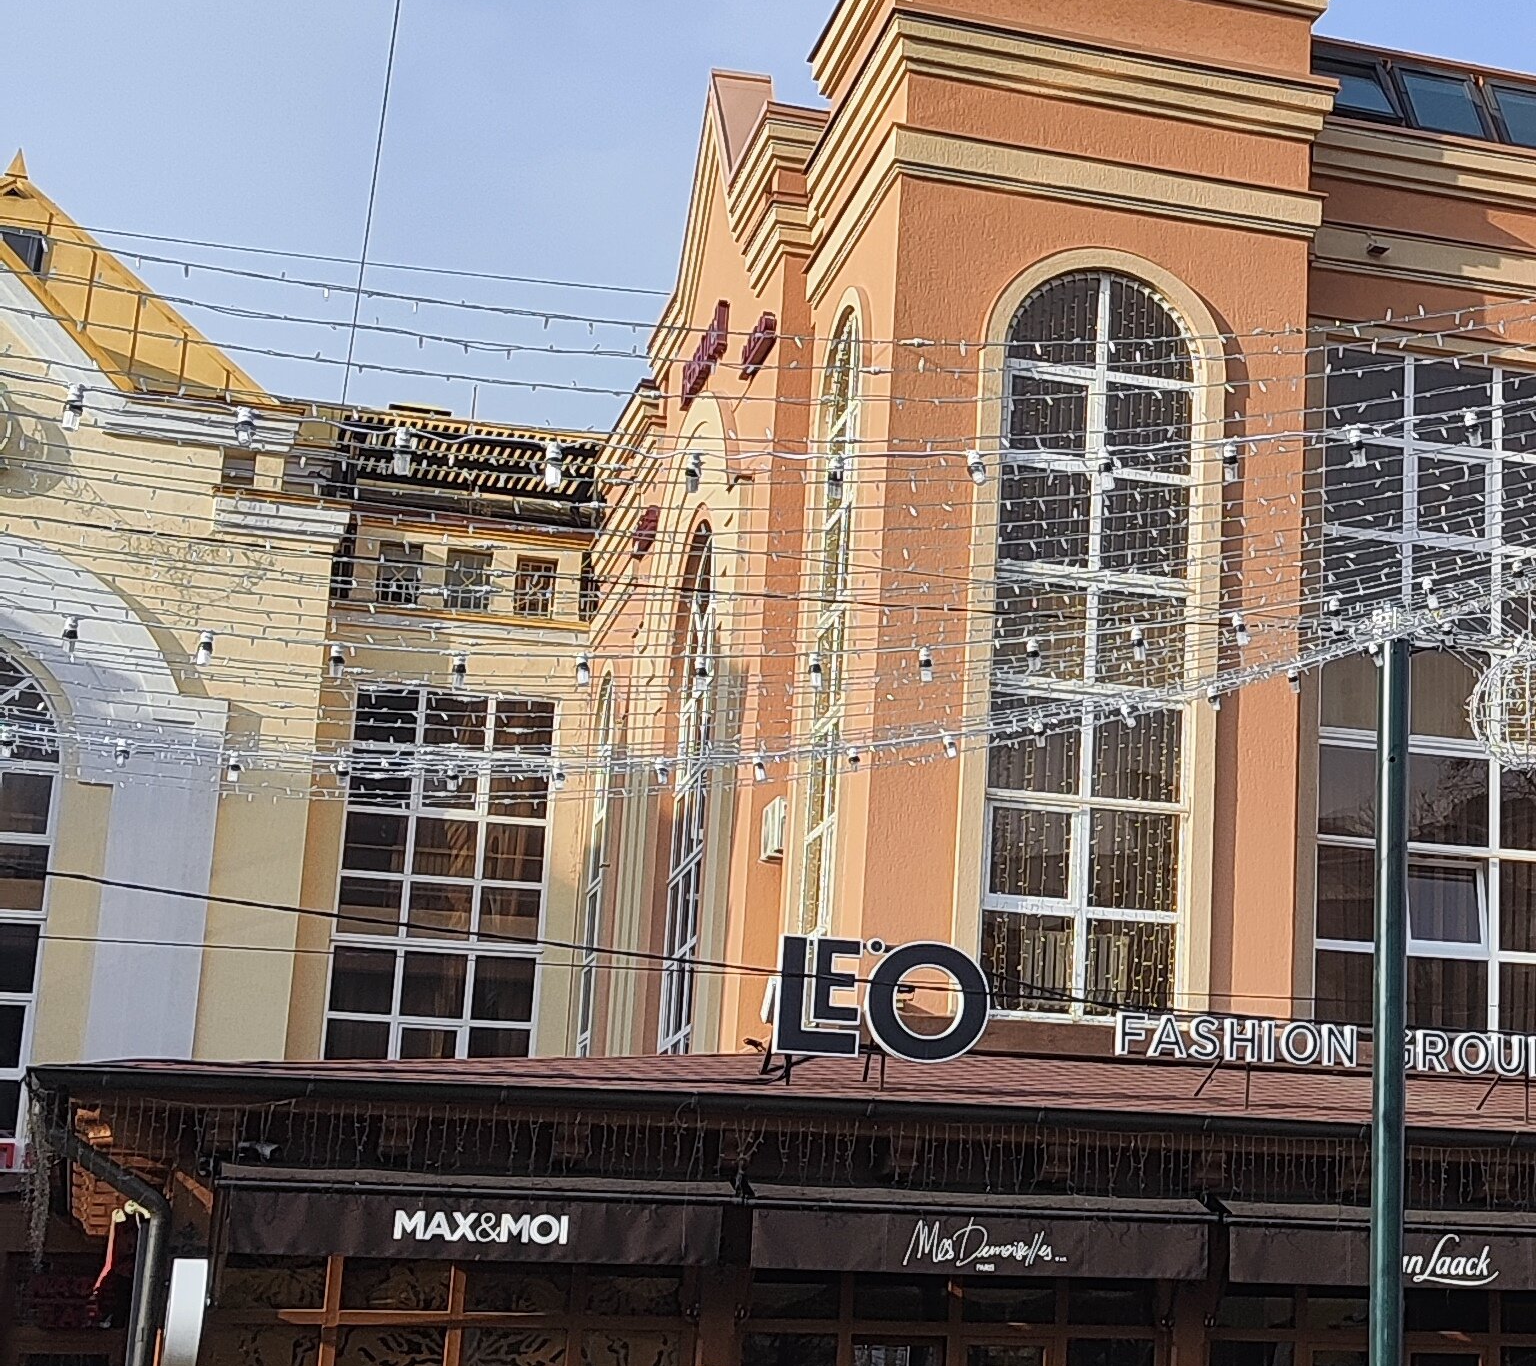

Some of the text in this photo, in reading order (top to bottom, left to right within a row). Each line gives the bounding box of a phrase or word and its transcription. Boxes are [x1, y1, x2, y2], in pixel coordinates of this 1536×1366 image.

[772, 934, 990, 1063] LEO
[1114, 1012, 1358, 1068] FASHION
[393, 1210, 570, 1245] MAX&MOI
